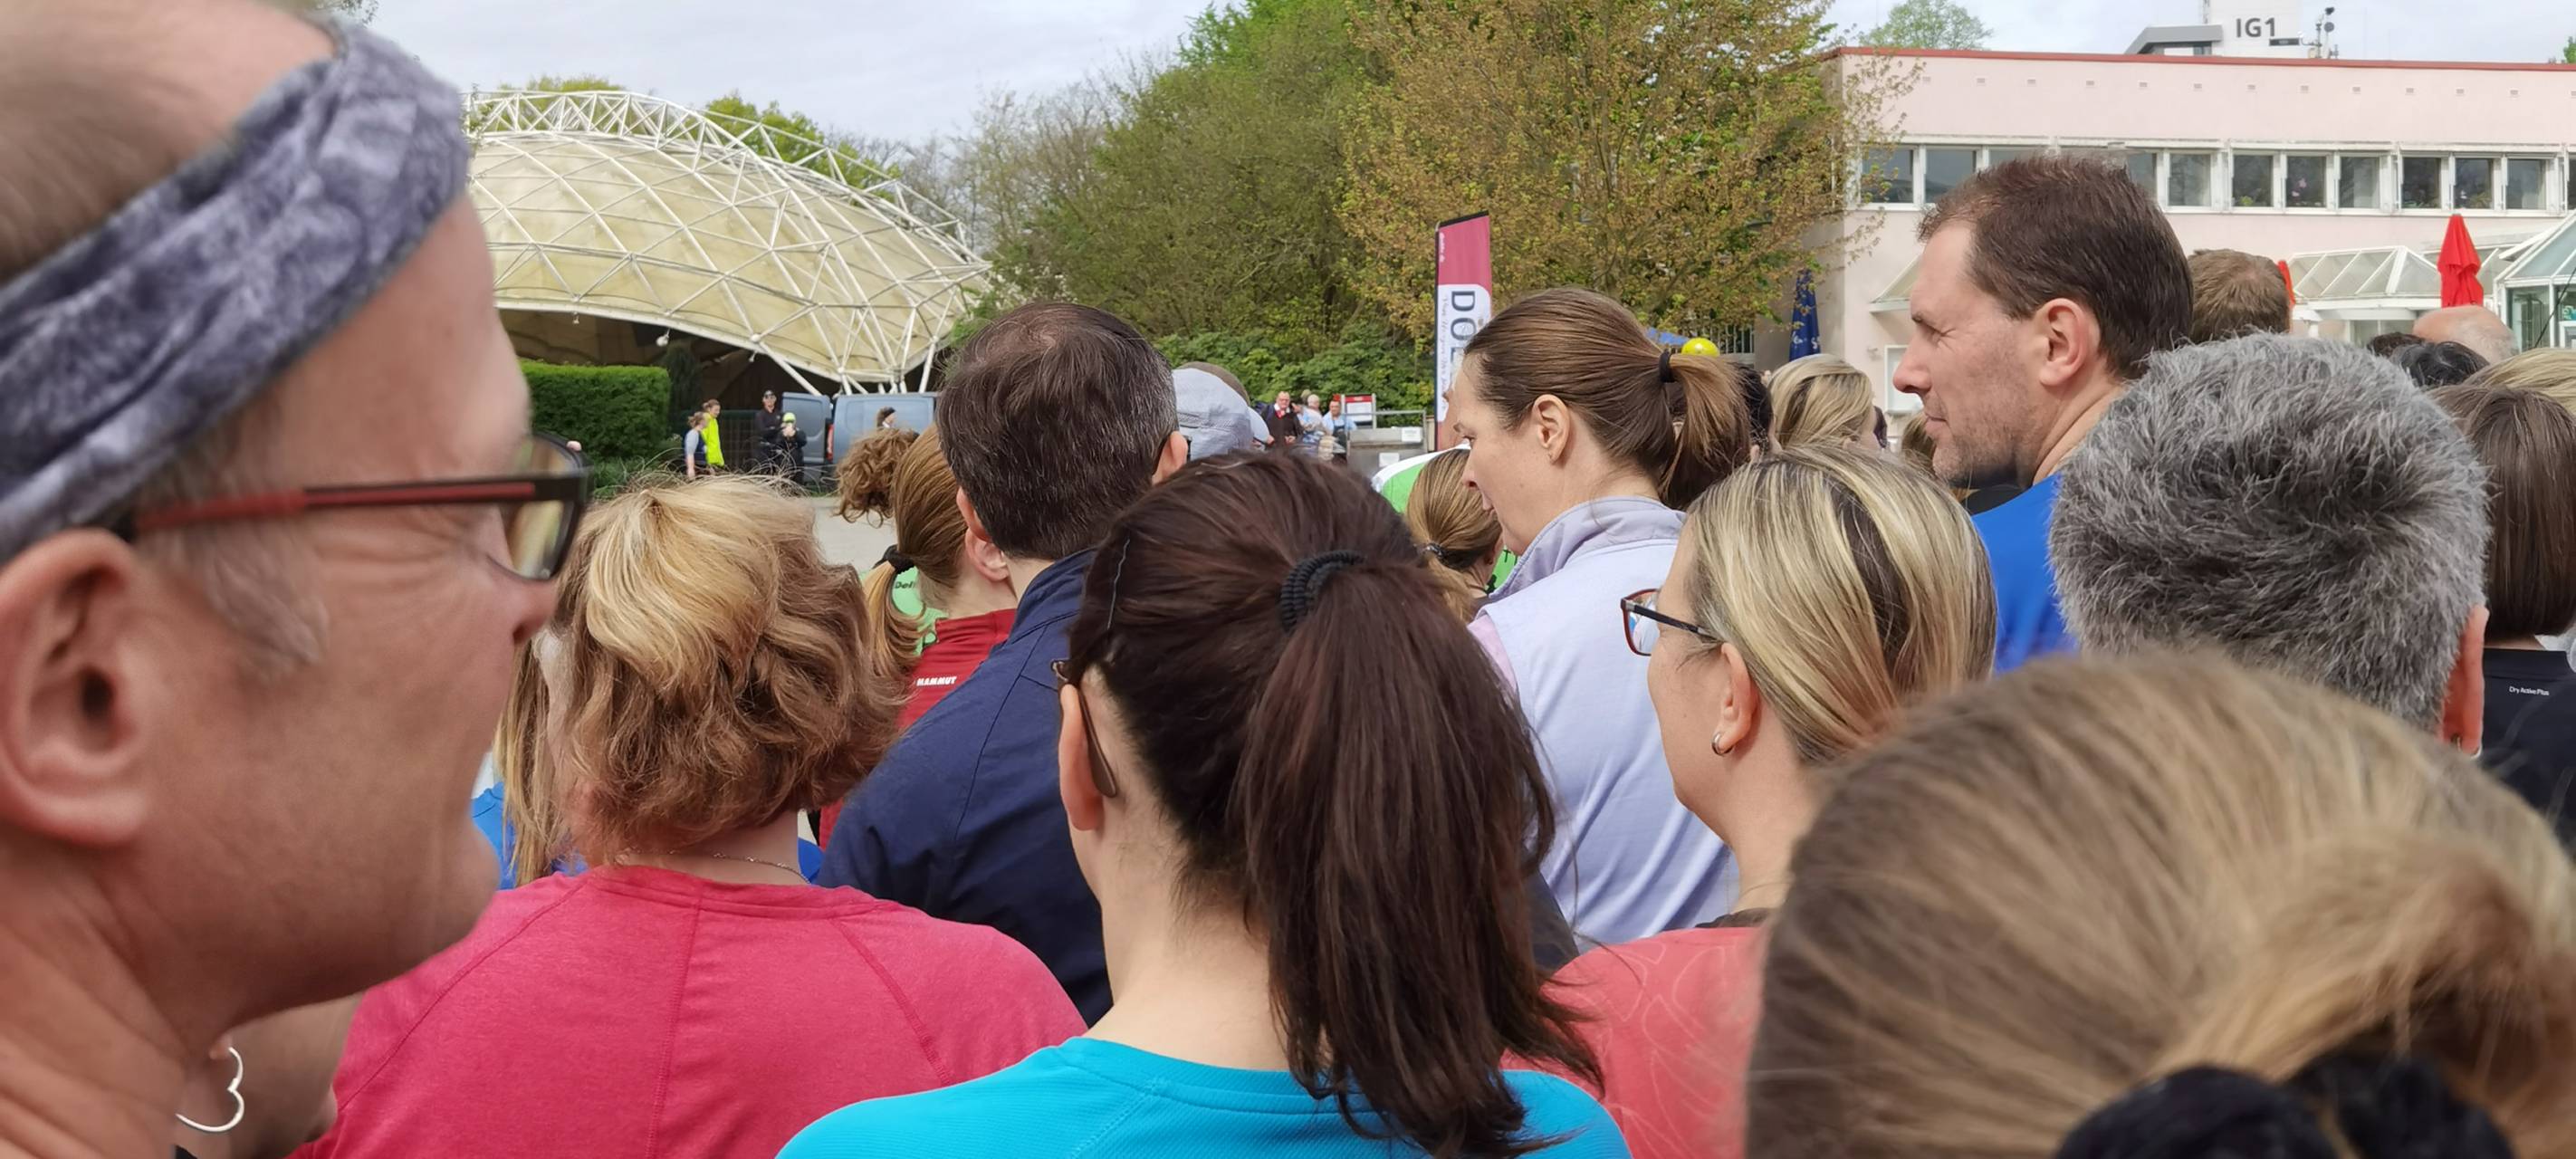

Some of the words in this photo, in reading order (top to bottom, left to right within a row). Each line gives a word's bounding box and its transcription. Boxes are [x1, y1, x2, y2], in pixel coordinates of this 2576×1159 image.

[2236, 17, 2275, 38] IG1
[915, 675, 957, 686] MAMMUT
[2509, 685, 2519, 694] Dry
[2537, 688, 2550, 696] Plus
